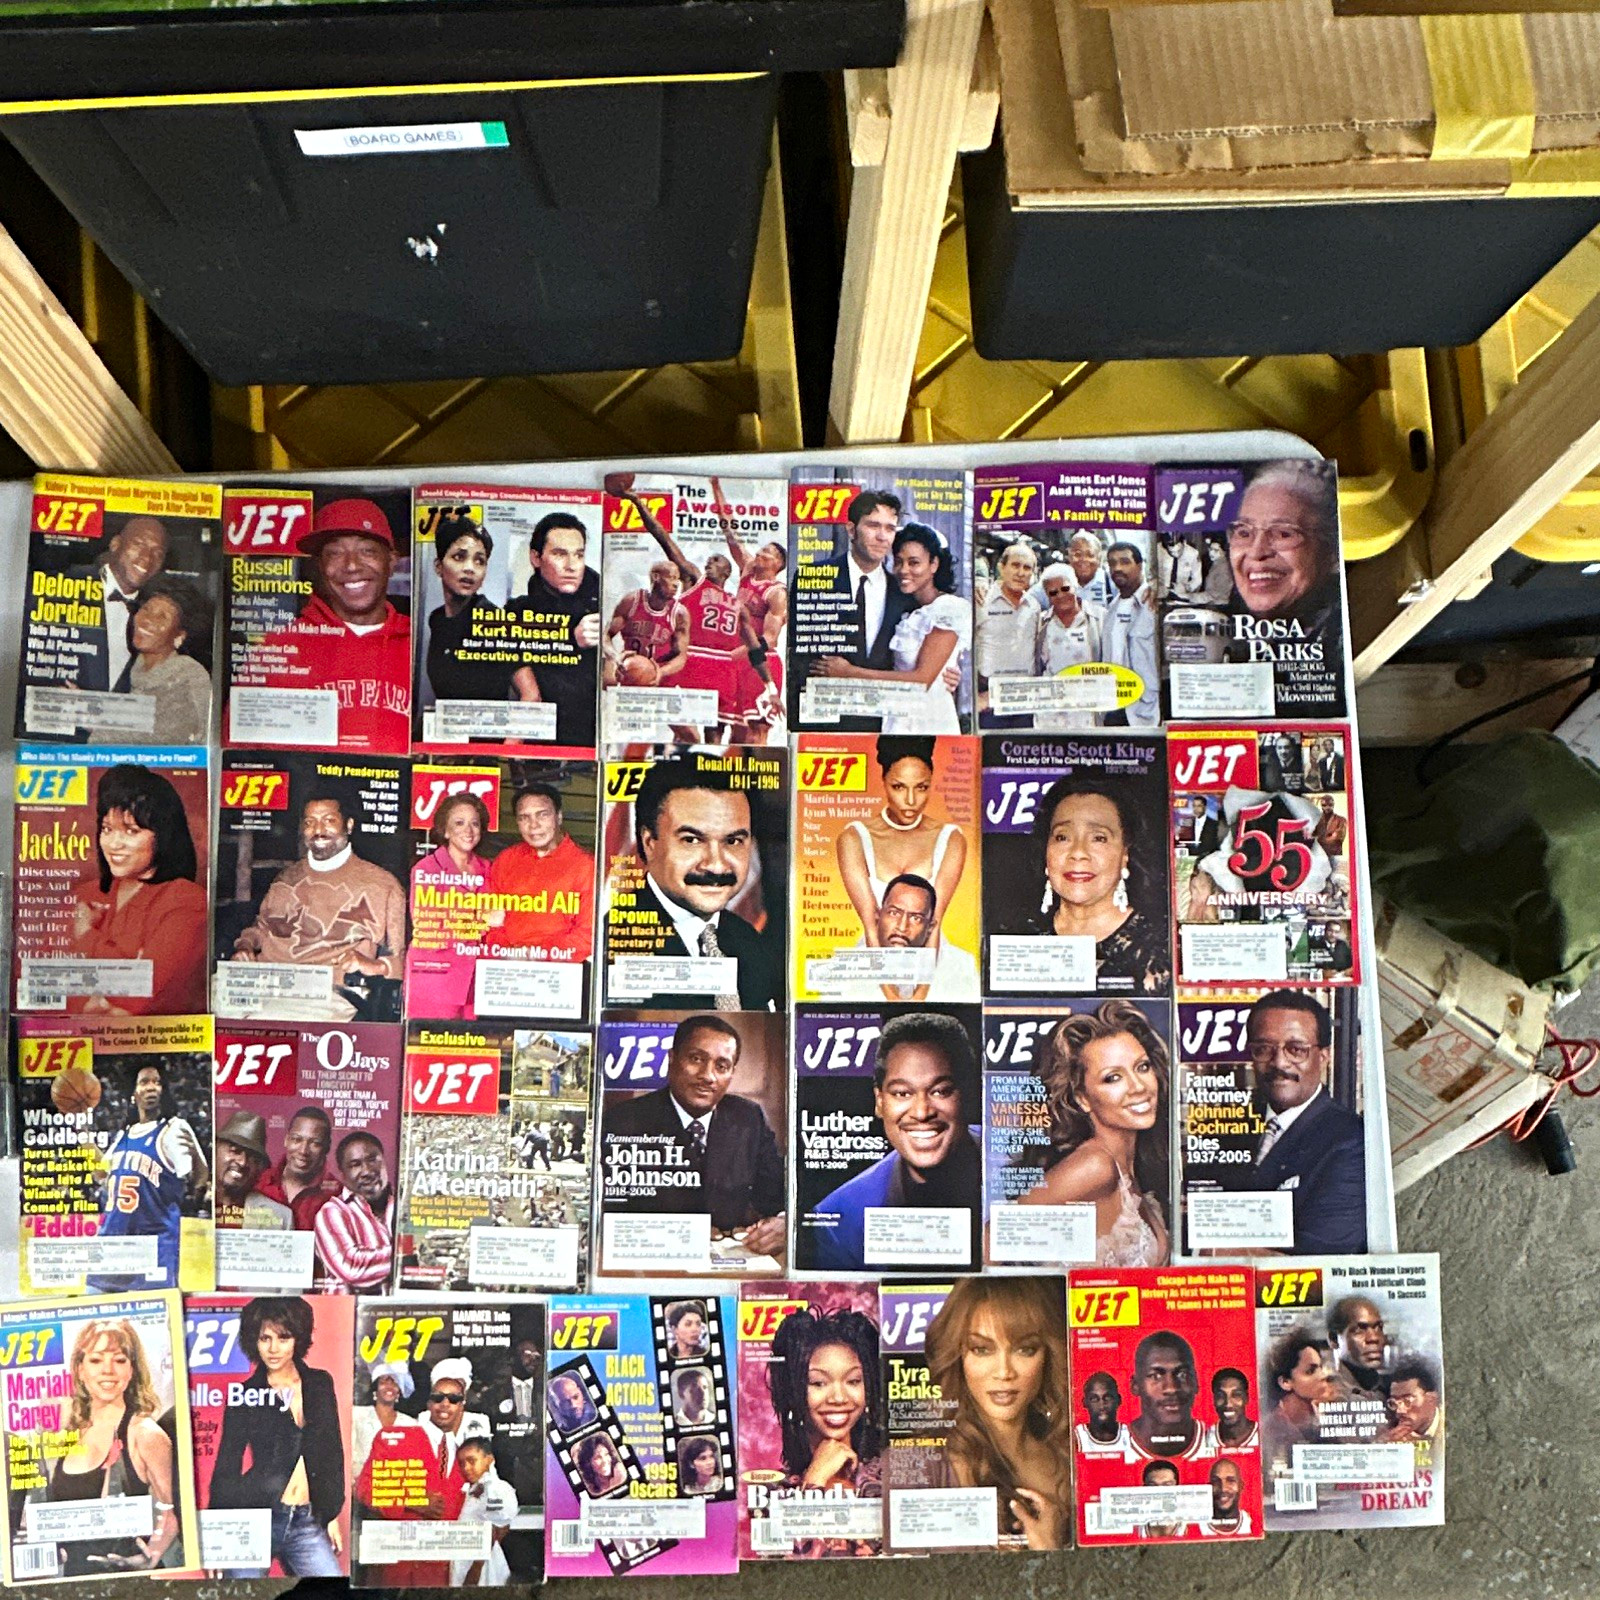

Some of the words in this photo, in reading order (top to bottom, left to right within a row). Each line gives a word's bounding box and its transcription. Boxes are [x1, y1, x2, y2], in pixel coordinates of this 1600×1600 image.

[350, 134, 400, 146] BOARD
[404, 131, 456, 142] GAMES
[1060, 475, 1091, 485] James
[1094, 475, 1115, 485] Earl
[1117, 476, 1146, 486] Jones
[676, 485, 706, 498] The
[1050, 486, 1072, 496] And
[1074, 487, 1110, 497] Robert
[1113, 487, 1146, 497] Duvall
[795, 489, 852, 520] JET
[981, 487, 1037, 519] JET
[1085, 498, 1109, 508] Star
[1112, 499, 1121, 508] In
[1123, 499, 1146, 509] Film
[1160, 482, 1235, 524] JET
[37, 501, 97, 531] JET
[610, 497, 666, 529] JET
[1048, 510, 1061, 521] 'A
[1063, 510, 1105, 523] Family
[1108, 511, 1146, 524] Thing'
[228, 505, 305, 545] JET
[233, 559, 293, 576] Russell
[798, 565, 839, 579] Timothy
[33, 571, 103, 600] Deloris
[232, 576, 313, 594] Simmons
[797, 578, 833, 590] Hutton
[30, 598, 102, 626] Jordan
[472, 608, 517, 622] Halle
[523, 610, 570, 626] Berry
[703, 608, 736, 635] 23
[1233, 615, 1306, 640] ROSA
[472, 624, 506, 637] Kurt
[514, 626, 569, 640] Russell
[463, 639, 482, 647] Star
[496, 640, 517, 649] New
[520, 641, 550, 650] Action
[553, 642, 573, 651] Film
[1247, 640, 1324, 662] PARKS
[454, 651, 519, 662] 'Executive
[523, 652, 581, 665] Decision'
[1000, 741, 1064, 756] Coretta
[1067, 743, 1112, 757] Scott
[1115, 743, 1156, 761] King
[317, 765, 343, 776] Teddy
[345, 766, 399, 779] Pendergrass
[697, 756, 732, 771] Ronald
[735, 758, 746, 771] H.
[749, 758, 779, 772] Brown
[802, 757, 858, 787] JET
[1175, 744, 1246, 785] JET
[18, 770, 77, 798] JET
[608, 765, 656, 796] JE
[729, 776, 779, 789] 1941-1996
[225, 775, 282, 807] JET
[987, 781, 1055, 825] JE
[19, 821, 90, 862] Jackée
[1228, 800, 1312, 891] 55
[19, 867, 80, 878] Discusses
[415, 870, 484, 886] Exclusive
[803, 873, 830, 883] Thin
[415, 886, 547, 913] Muhammad
[551, 892, 580, 915] Ali
[610, 892, 636, 907] Ron
[803, 887, 829, 896] Line
[1207, 892, 1327, 905] ANNIVERSARY
[802, 901, 853, 910] Between
[609, 909, 660, 924] Brown,
[802, 914, 829, 924] Love
[802, 927, 826, 937] And
[453, 943, 489, 956] 'Don't
[491, 945, 528, 958] Count
[530, 946, 547, 959] Me
[550, 946, 576, 959] Out'
[301, 1032, 320, 1042] The
[420, 1031, 485, 1046] Exclusive
[1183, 1009, 1251, 1055] JET
[25, 1040, 85, 1072] JET
[804, 1027, 881, 1069] JET
[215, 1044, 293, 1085] JET
[414, 1063, 493, 1105] JET
[991, 1076, 1017, 1085] FROM
[1019, 1076, 1041, 1085] MISS
[1186, 1072, 1235, 1087] Famed
[991, 1085, 1032, 1094] AMERICA
[1033, 1085, 1045, 1094] TO
[1186, 1088, 1251, 1106] Attorney
[991, 1103, 1048, 1115] VANESSA
[1188, 1104, 1244, 1120] Johnnie
[1249, 1105, 1261, 1119] L.
[24, 1110, 93, 1127] Whoopi
[802, 1110, 873, 1132] Luther
[991, 1116, 1051, 1128] WILLIAMS
[1187, 1119, 1249, 1135] Cochran
[23, 1129, 109, 1148] Goldberg
[606, 1134, 675, 1145] Remembering
[801, 1132, 888, 1150] Vandross:
[991, 1128, 1025, 1136] SHOWS
[1026, 1128, 1044, 1136] SHE
[991, 1137, 1009, 1145] HAS
[1011, 1137, 1051, 1146] STAYING
[991, 1145, 1024, 1153] POWER
[1188, 1136, 1220, 1151] Dies
[412, 1147, 499, 1172] Katrina
[605, 1145, 662, 1166] John
[665, 1146, 690, 1166] H.
[804, 1149, 829, 1159] R&B
[832, 1151, 885, 1161] Superstar
[1187, 1151, 1251, 1163] 1937-2005
[605, 1165, 701, 1187] Johnson
[605, 1187, 656, 1196] 1918-2005
[73, 1202, 98, 1213] Film
[25, 1215, 104, 1237] 'Eddie'
[1261, 1272, 1317, 1305] JET
[1076, 1291, 1130, 1323] JET
[554, 1316, 611, 1347] JET
[883, 1301, 944, 1345] JE
[0, 1329, 55, 1366] JET
[186, 1319, 241, 1366] ET
[360, 1317, 444, 1363] JET
[605, 1355, 645, 1378] BLACK
[889, 1359, 930, 1382] Tyra
[7, 1370, 74, 1400] Mariah
[606, 1382, 654, 1406] ACTORS
[889, 1381, 942, 1400] Banks
[227, 1383, 295, 1412] Berry
[8, 1403, 61, 1433] Carey
[644, 1463, 677, 1480] 1995
[629, 1480, 678, 1499] Oscars
[1361, 1492, 1433, 1511] DREAM'
